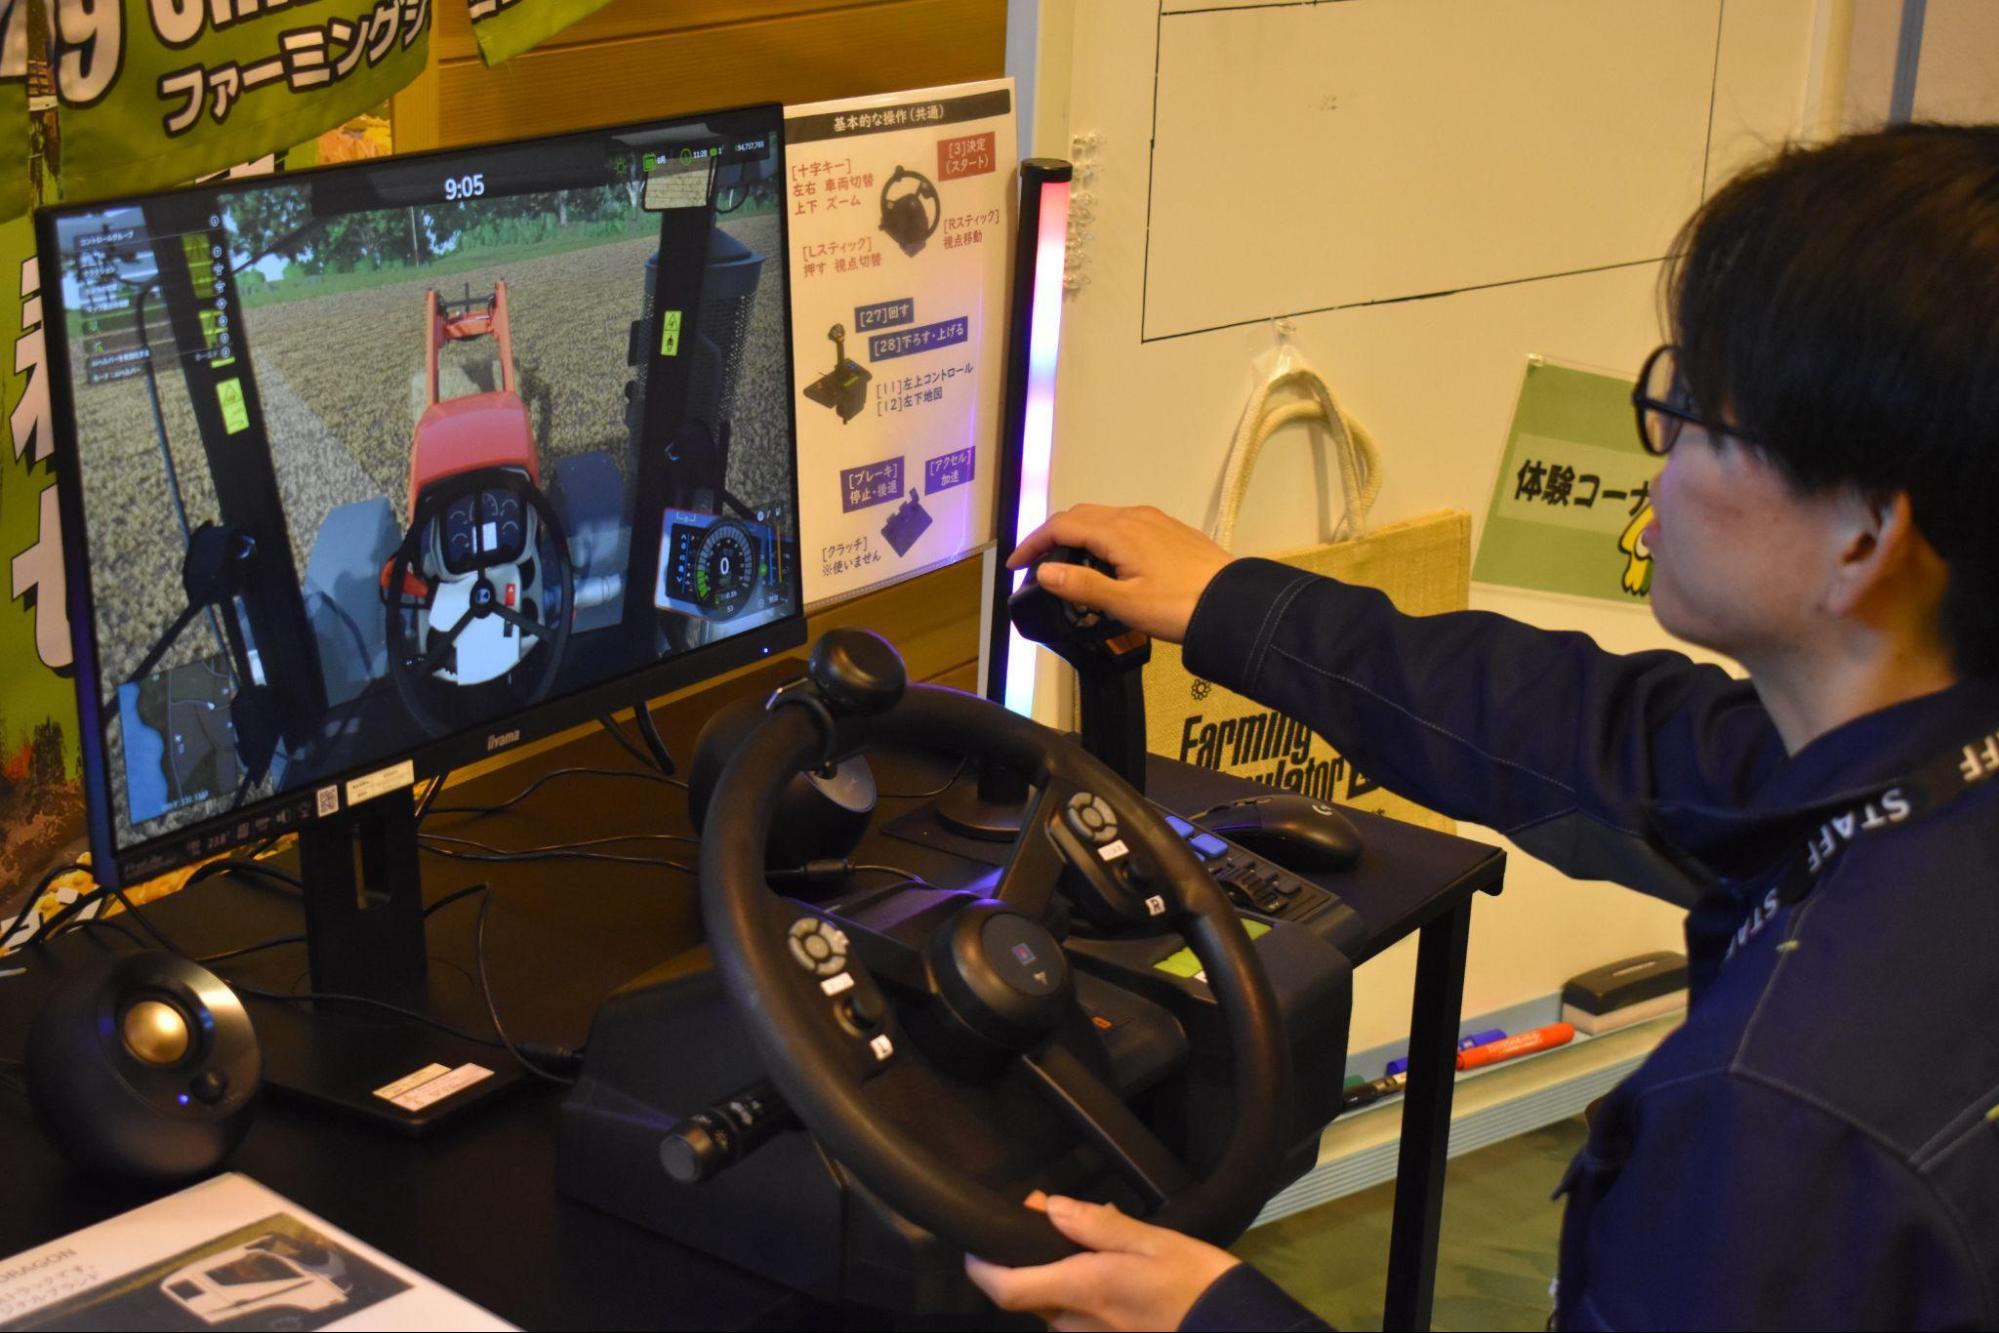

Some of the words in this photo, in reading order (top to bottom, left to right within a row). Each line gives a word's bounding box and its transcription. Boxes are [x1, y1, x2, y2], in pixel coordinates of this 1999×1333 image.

[445, 175, 485, 200] 9:05
[794, 200, 817, 216] 上下
[826, 197, 861, 210] ズーム
[860, 304, 909, 327] [27]回す
[1808, 788, 1910, 873] STAFF
